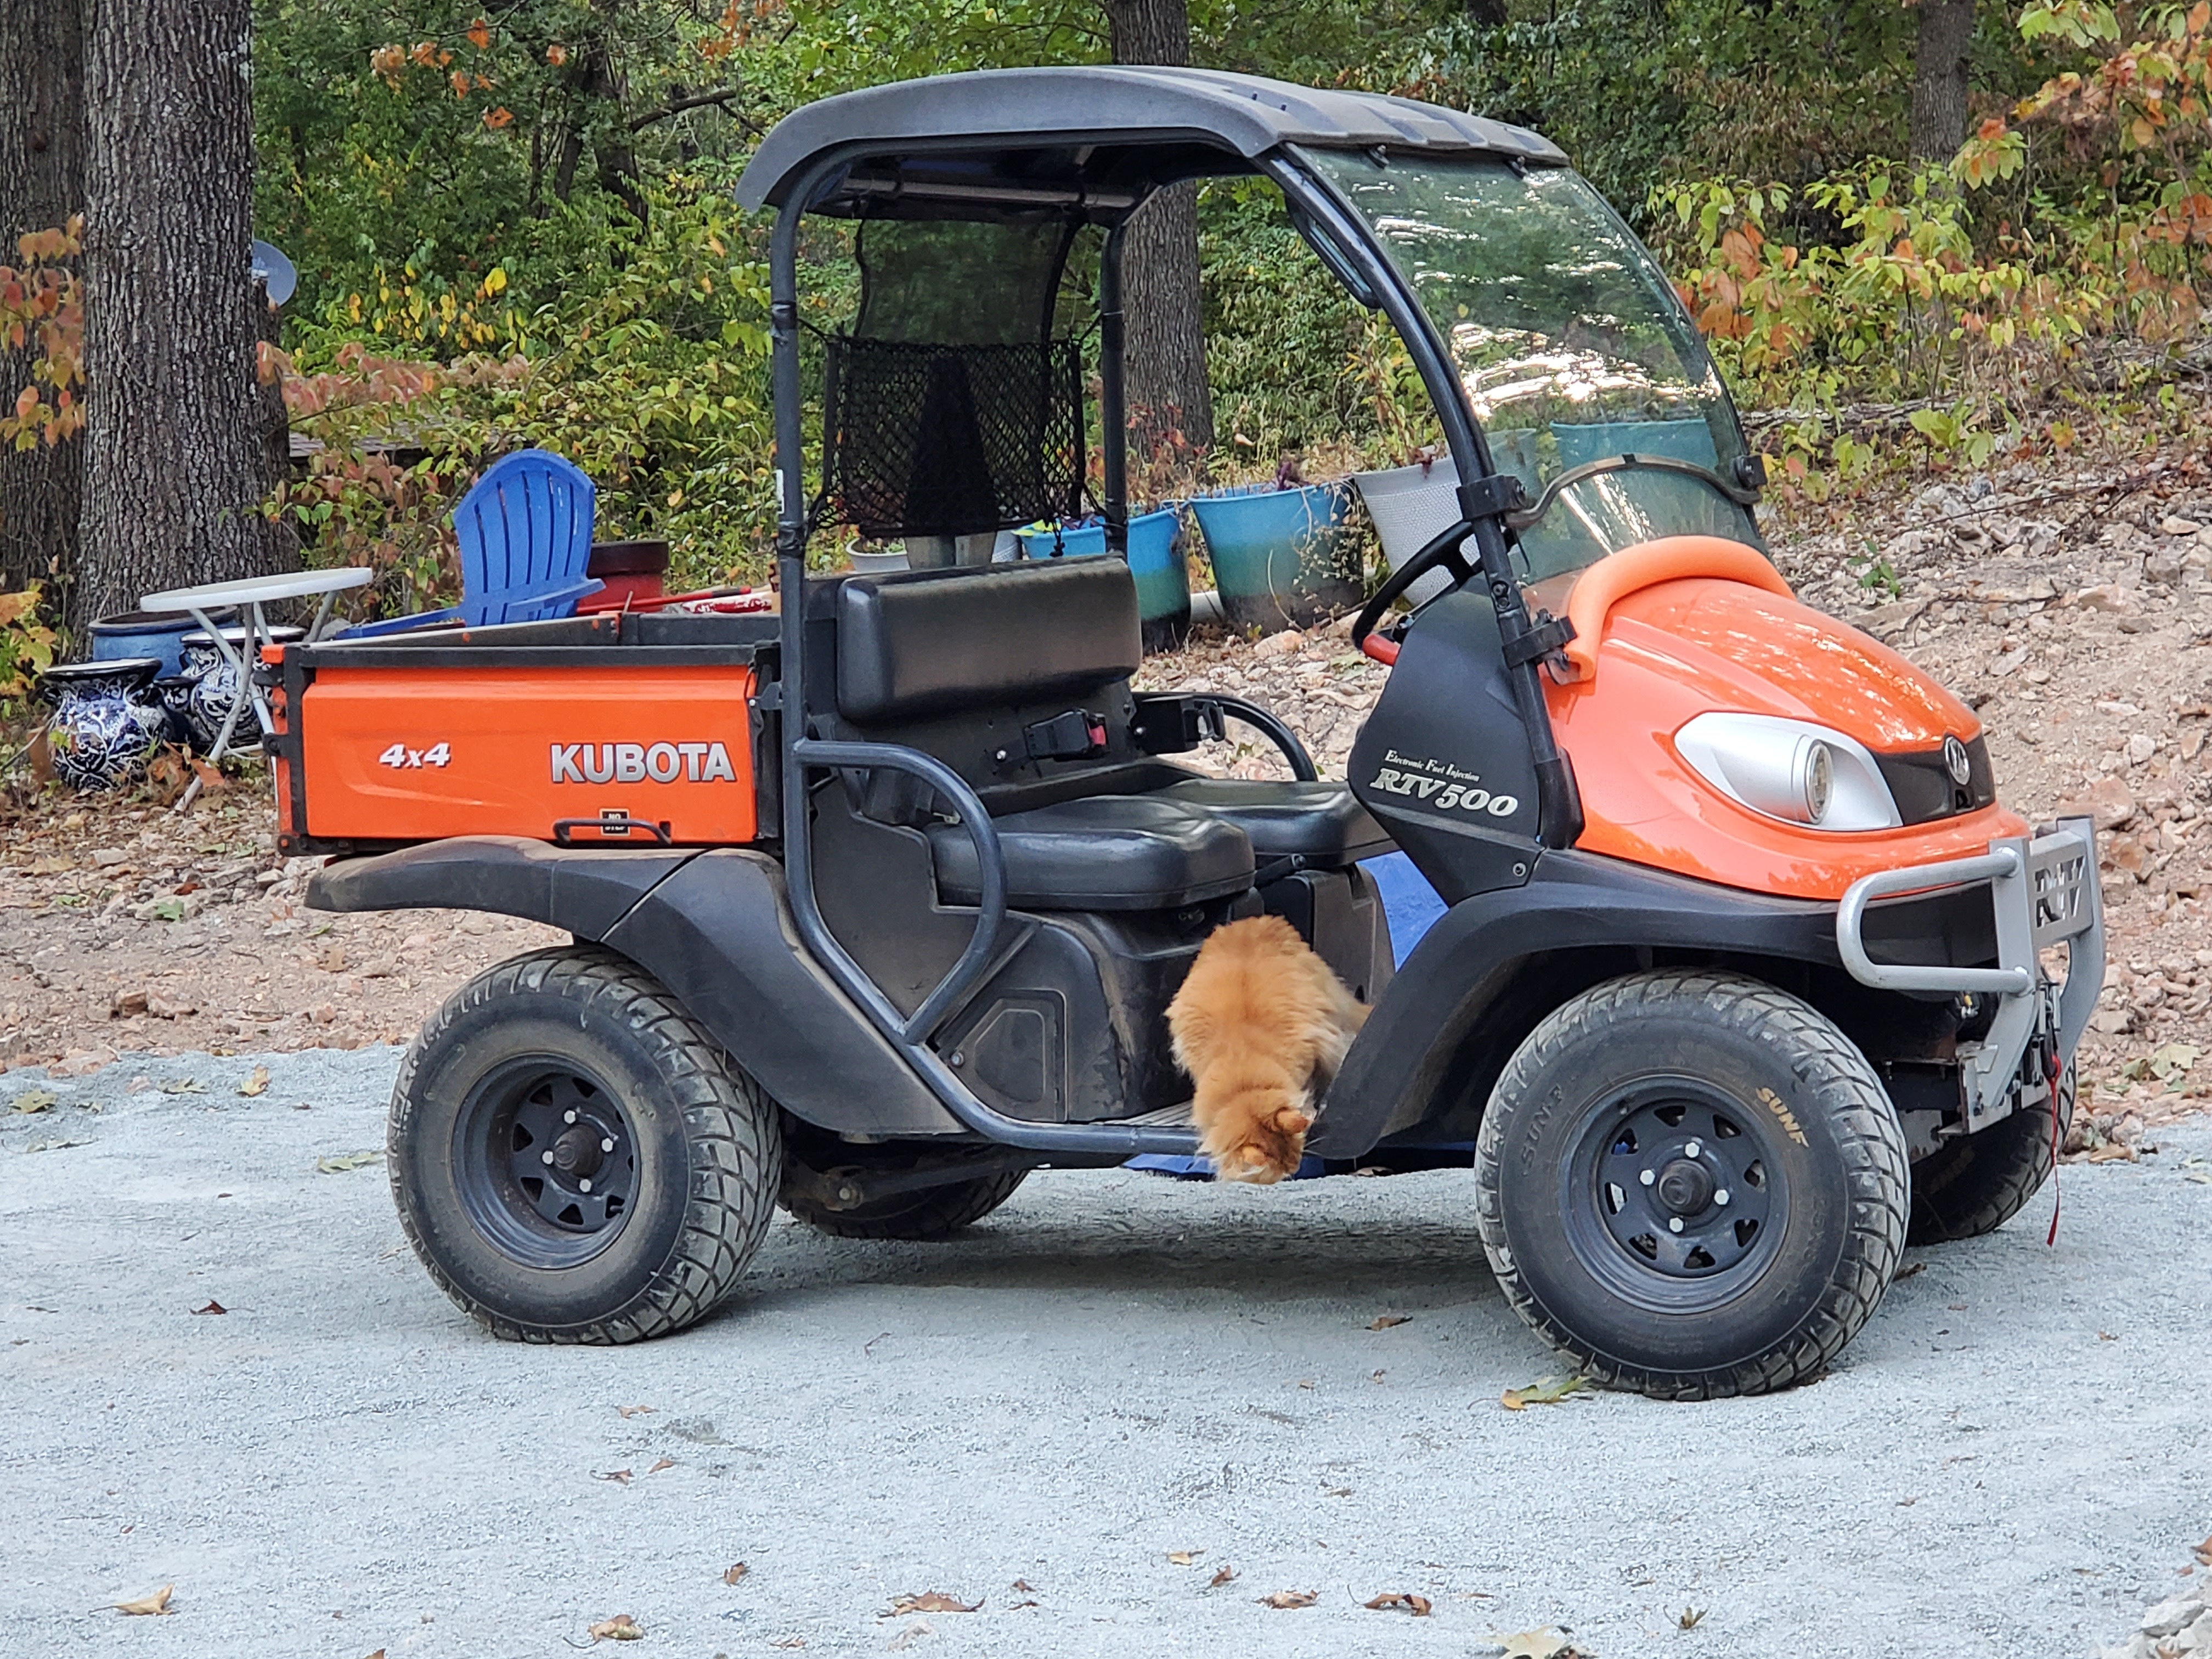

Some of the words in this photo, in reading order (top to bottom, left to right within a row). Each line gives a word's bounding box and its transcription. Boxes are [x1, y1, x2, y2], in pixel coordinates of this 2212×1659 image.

[379, 742, 450, 768] 4x4
[551, 742, 737, 783] KUBOTA
[1385, 749, 1425, 769] Electronic
[1425, 759, 1446, 774] Fuel
[1446, 763, 1480, 782] Injection
[1369, 768, 1519, 817] RTV500
[1756, 1087, 1809, 1148] SUNF
